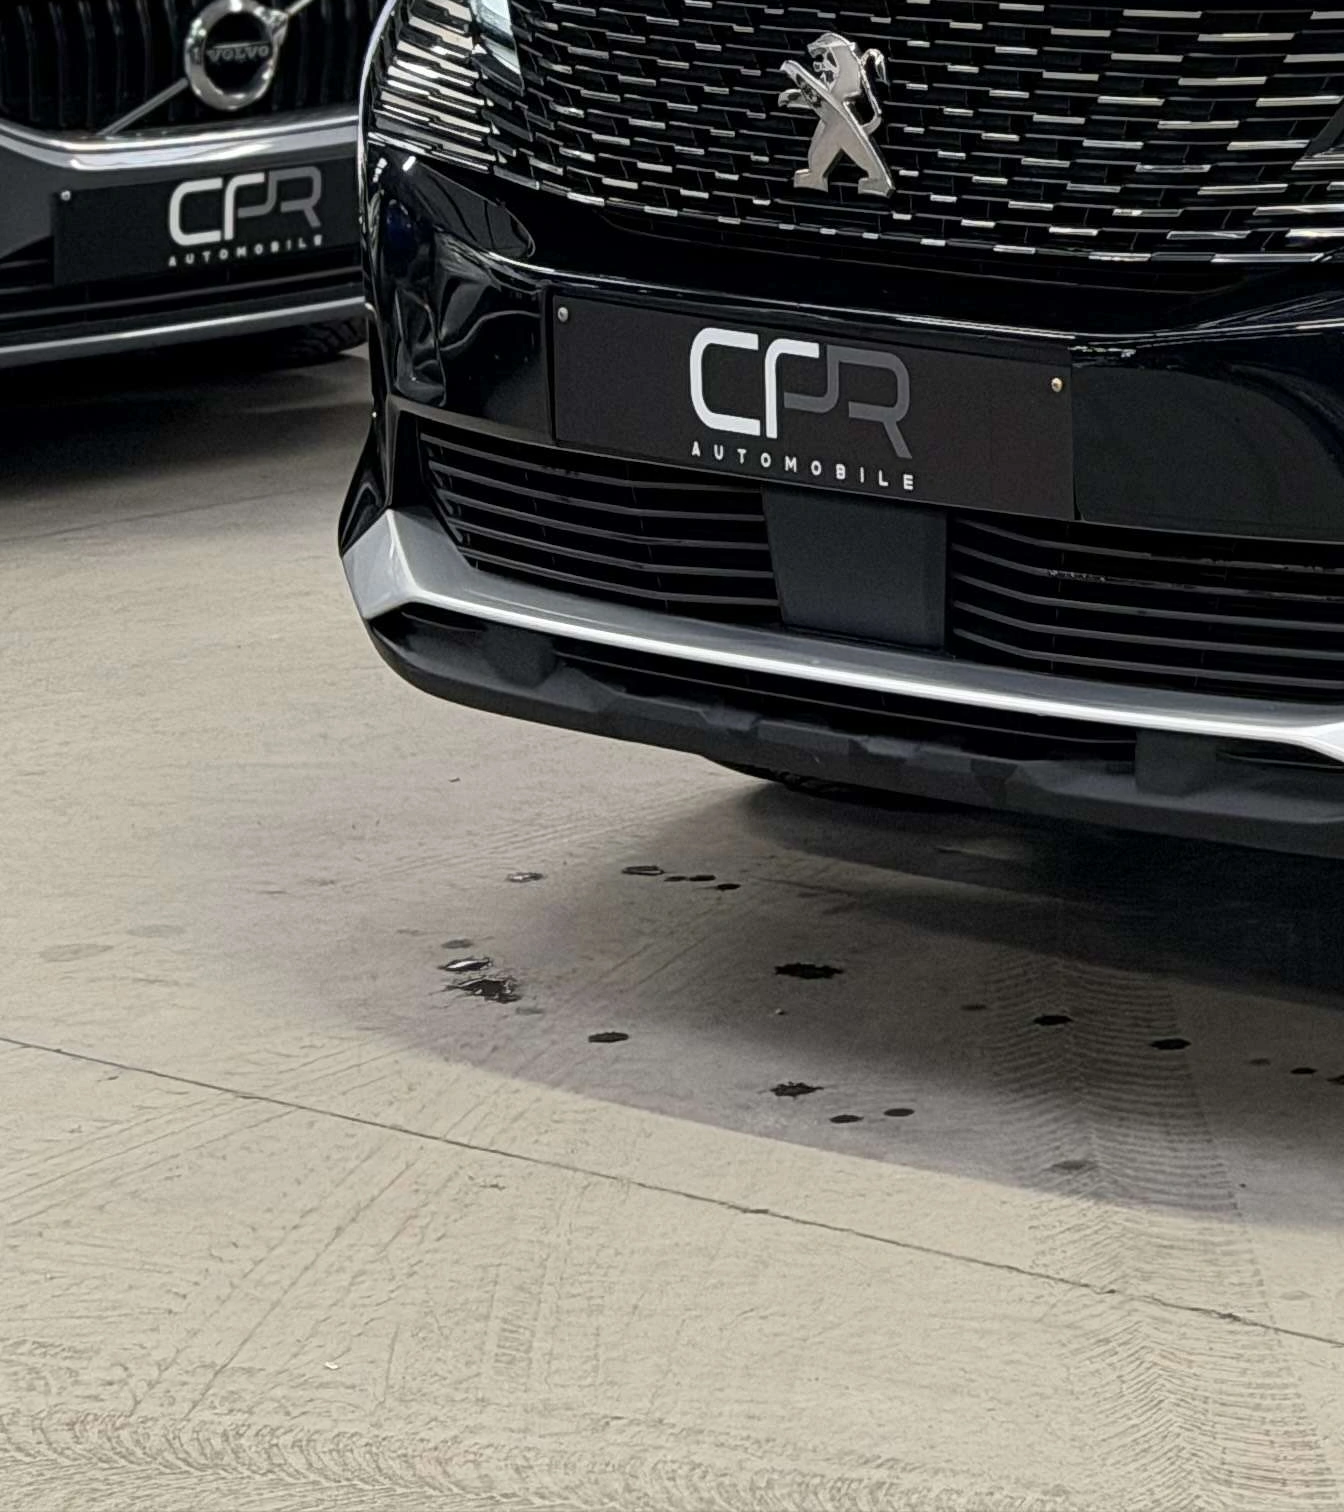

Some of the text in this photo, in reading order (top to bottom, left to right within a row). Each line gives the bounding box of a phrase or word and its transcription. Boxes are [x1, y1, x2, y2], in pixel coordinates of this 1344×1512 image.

[207, 45, 270, 62] VOLVO
[169, 166, 322, 246] CPR
[168, 235, 323, 267] AUTOMOBILE
[689, 327, 912, 460] CPR
[691, 441, 914, 491] AUTOMOBILE
